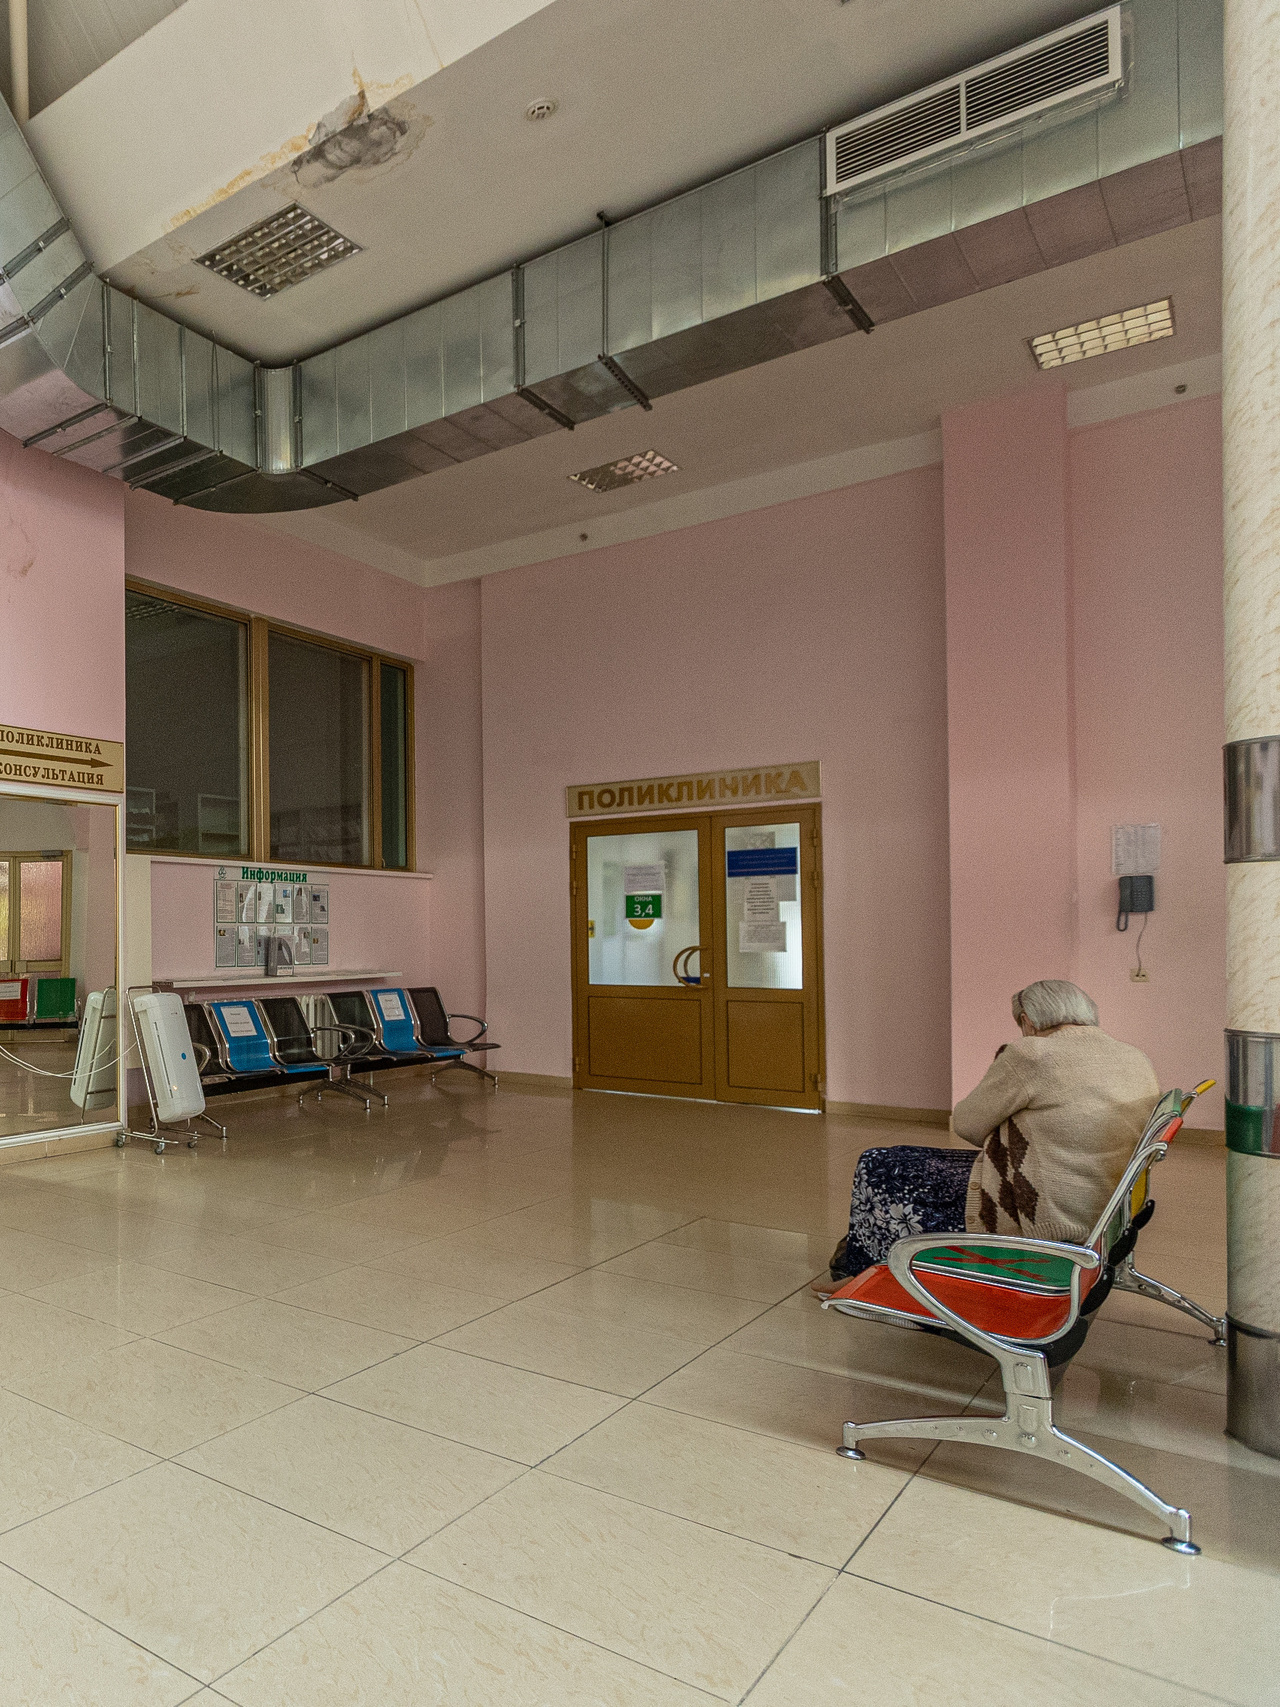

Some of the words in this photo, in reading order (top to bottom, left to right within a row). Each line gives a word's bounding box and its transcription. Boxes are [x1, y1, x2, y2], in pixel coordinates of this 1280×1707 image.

[577, 770, 808, 811] ПОЛИКЛИНИКА
[241, 866, 308, 884] Информация
[634, 904, 654, 917] 3,4
